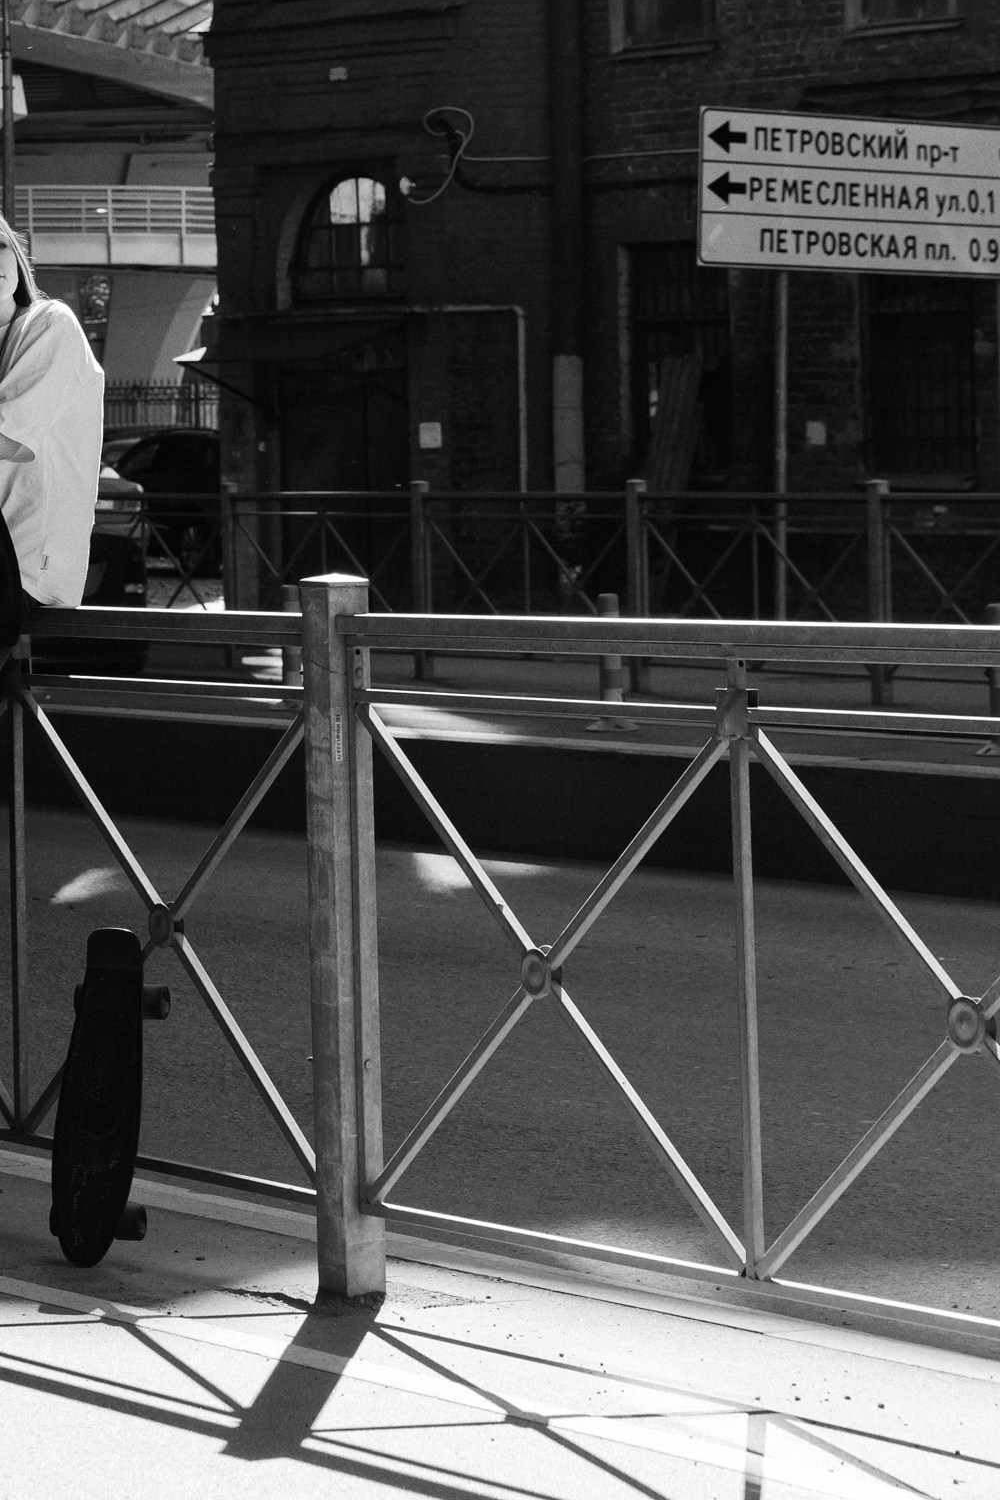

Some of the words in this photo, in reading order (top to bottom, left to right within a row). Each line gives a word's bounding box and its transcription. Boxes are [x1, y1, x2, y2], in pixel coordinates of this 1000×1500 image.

[754, 127, 909, 160] ПЕТРОВСКИЙ
[916, 144, 960, 169] пр-т
[749, 177, 929, 210] РЕМЕСЛЕННАЯ
[759, 228, 917, 260] ПЕТРОВСКАЯ
[924, 242, 957, 261] пл.
